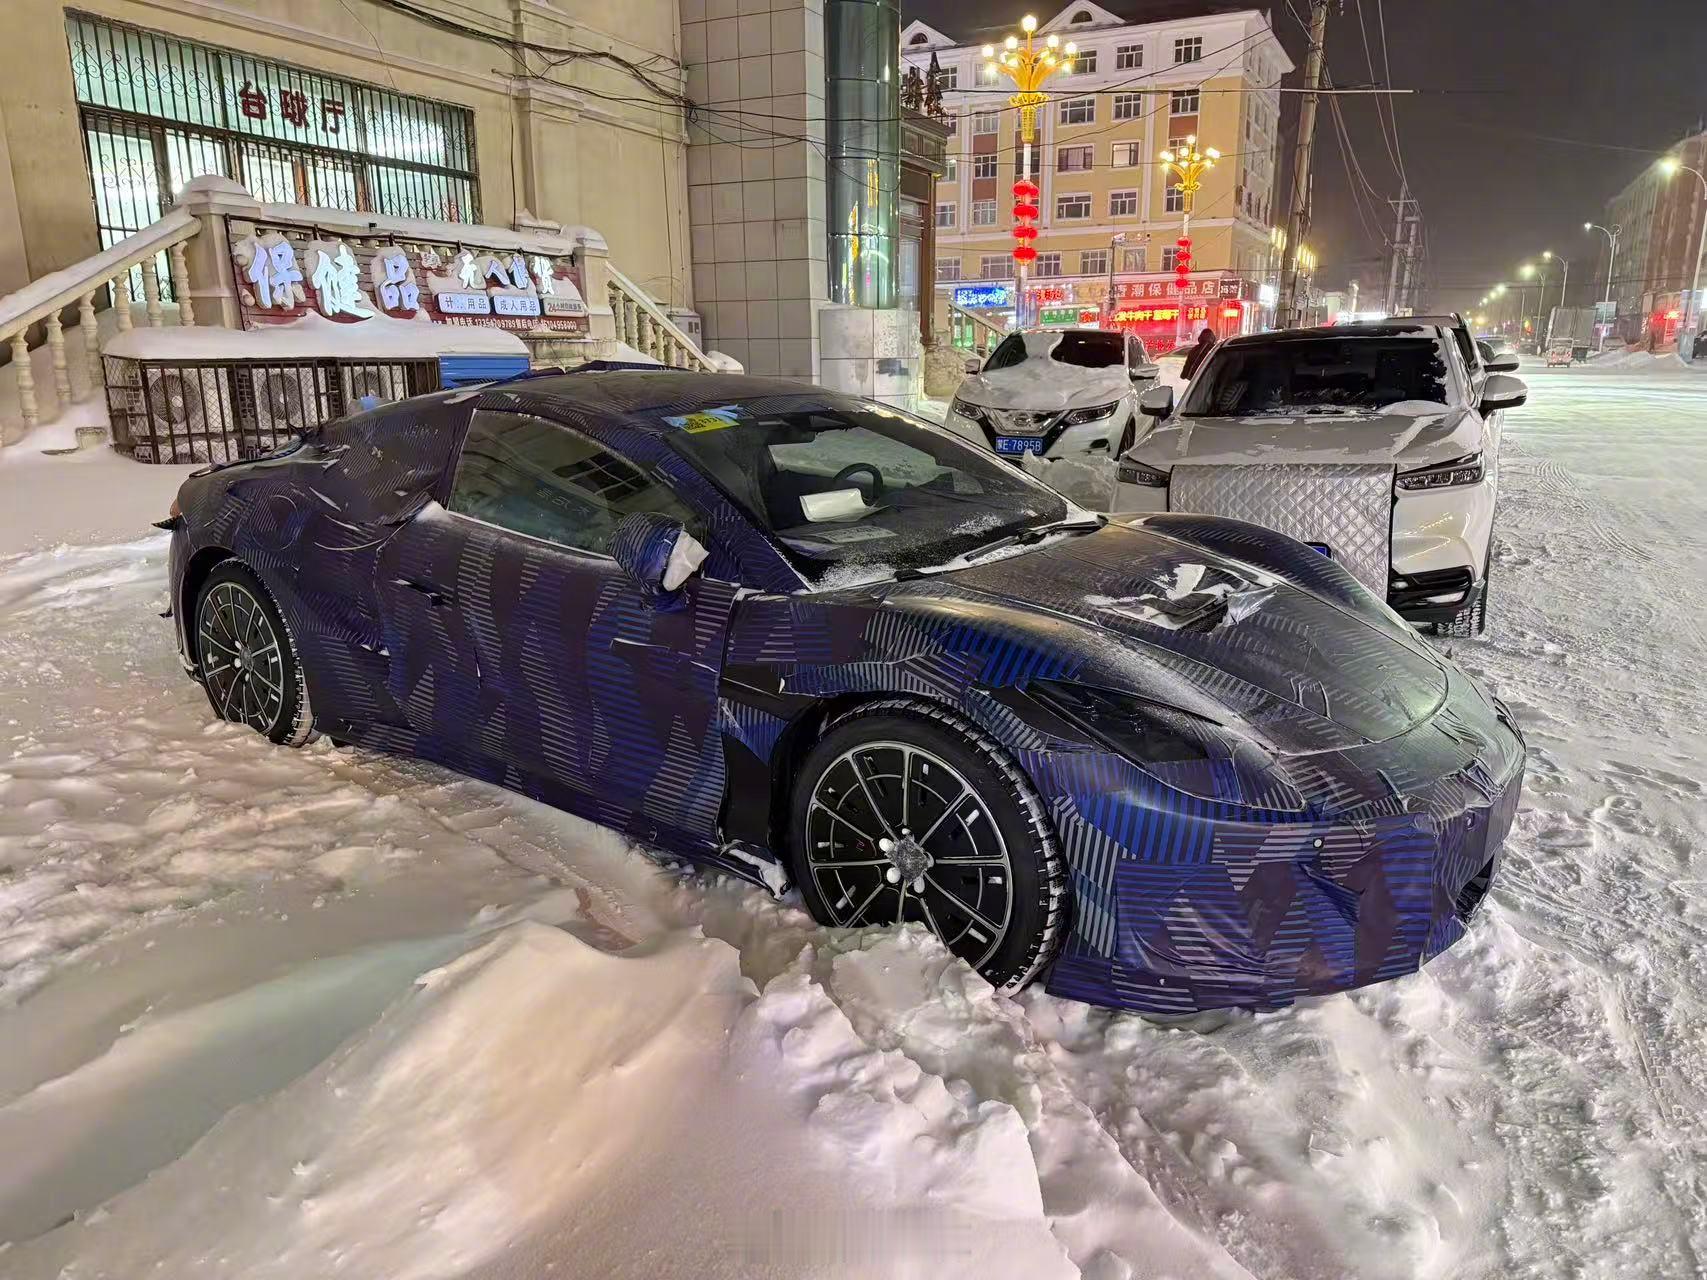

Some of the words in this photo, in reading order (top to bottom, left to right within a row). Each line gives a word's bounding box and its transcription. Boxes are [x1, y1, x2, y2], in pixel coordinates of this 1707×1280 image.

[239, 80, 346, 134] 台球厅
[248, 241, 421, 319] 保健品
[445, 296, 487, 310] 计用品
[500, 299, 537, 313] 成人用品
